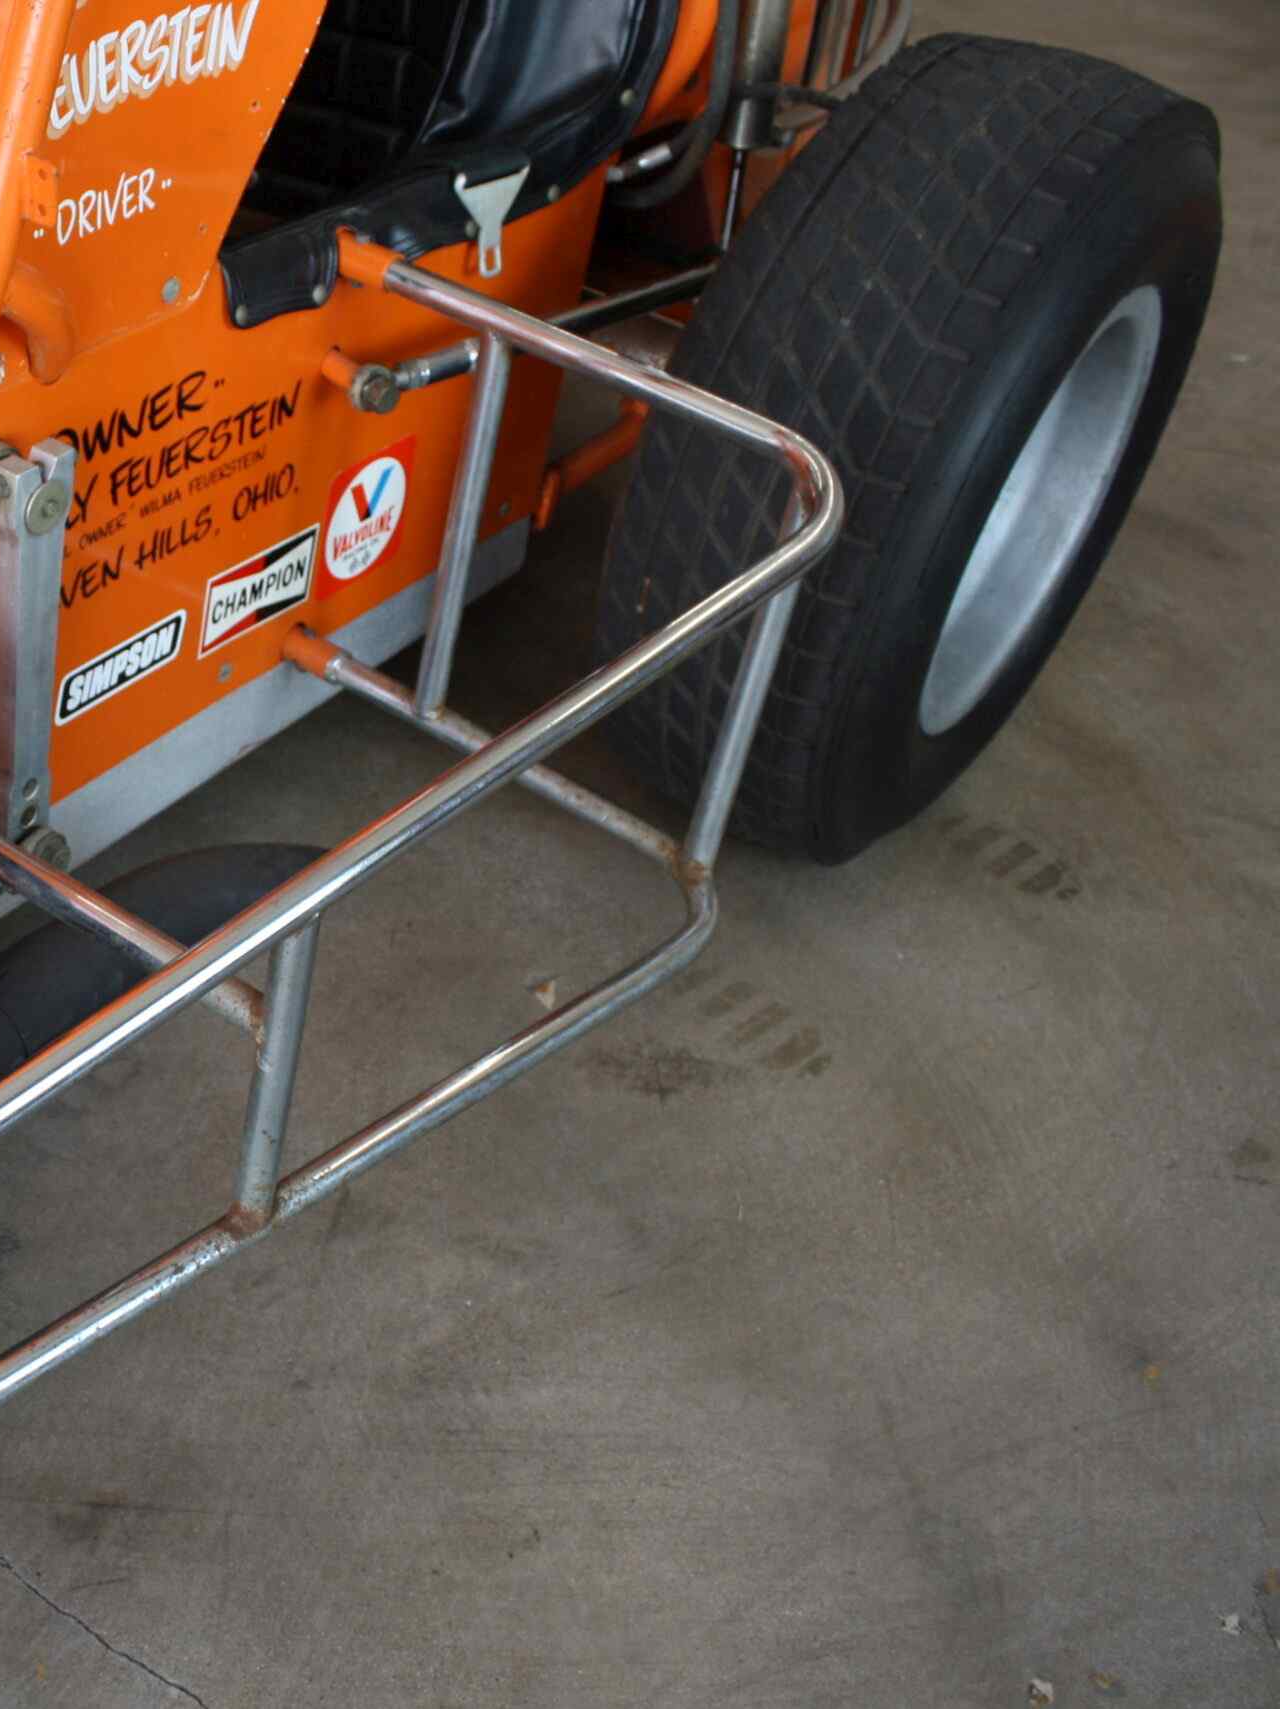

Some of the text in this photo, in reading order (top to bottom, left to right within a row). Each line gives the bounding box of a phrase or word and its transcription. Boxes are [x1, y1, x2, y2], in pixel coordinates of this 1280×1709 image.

[109, 379, 302, 507] FEUERSTEIN
[332, 506, 394, 561] VALVOLINE
[211, 556, 307, 625] CHAMPION
[66, 622, 178, 711] SIMPSON
